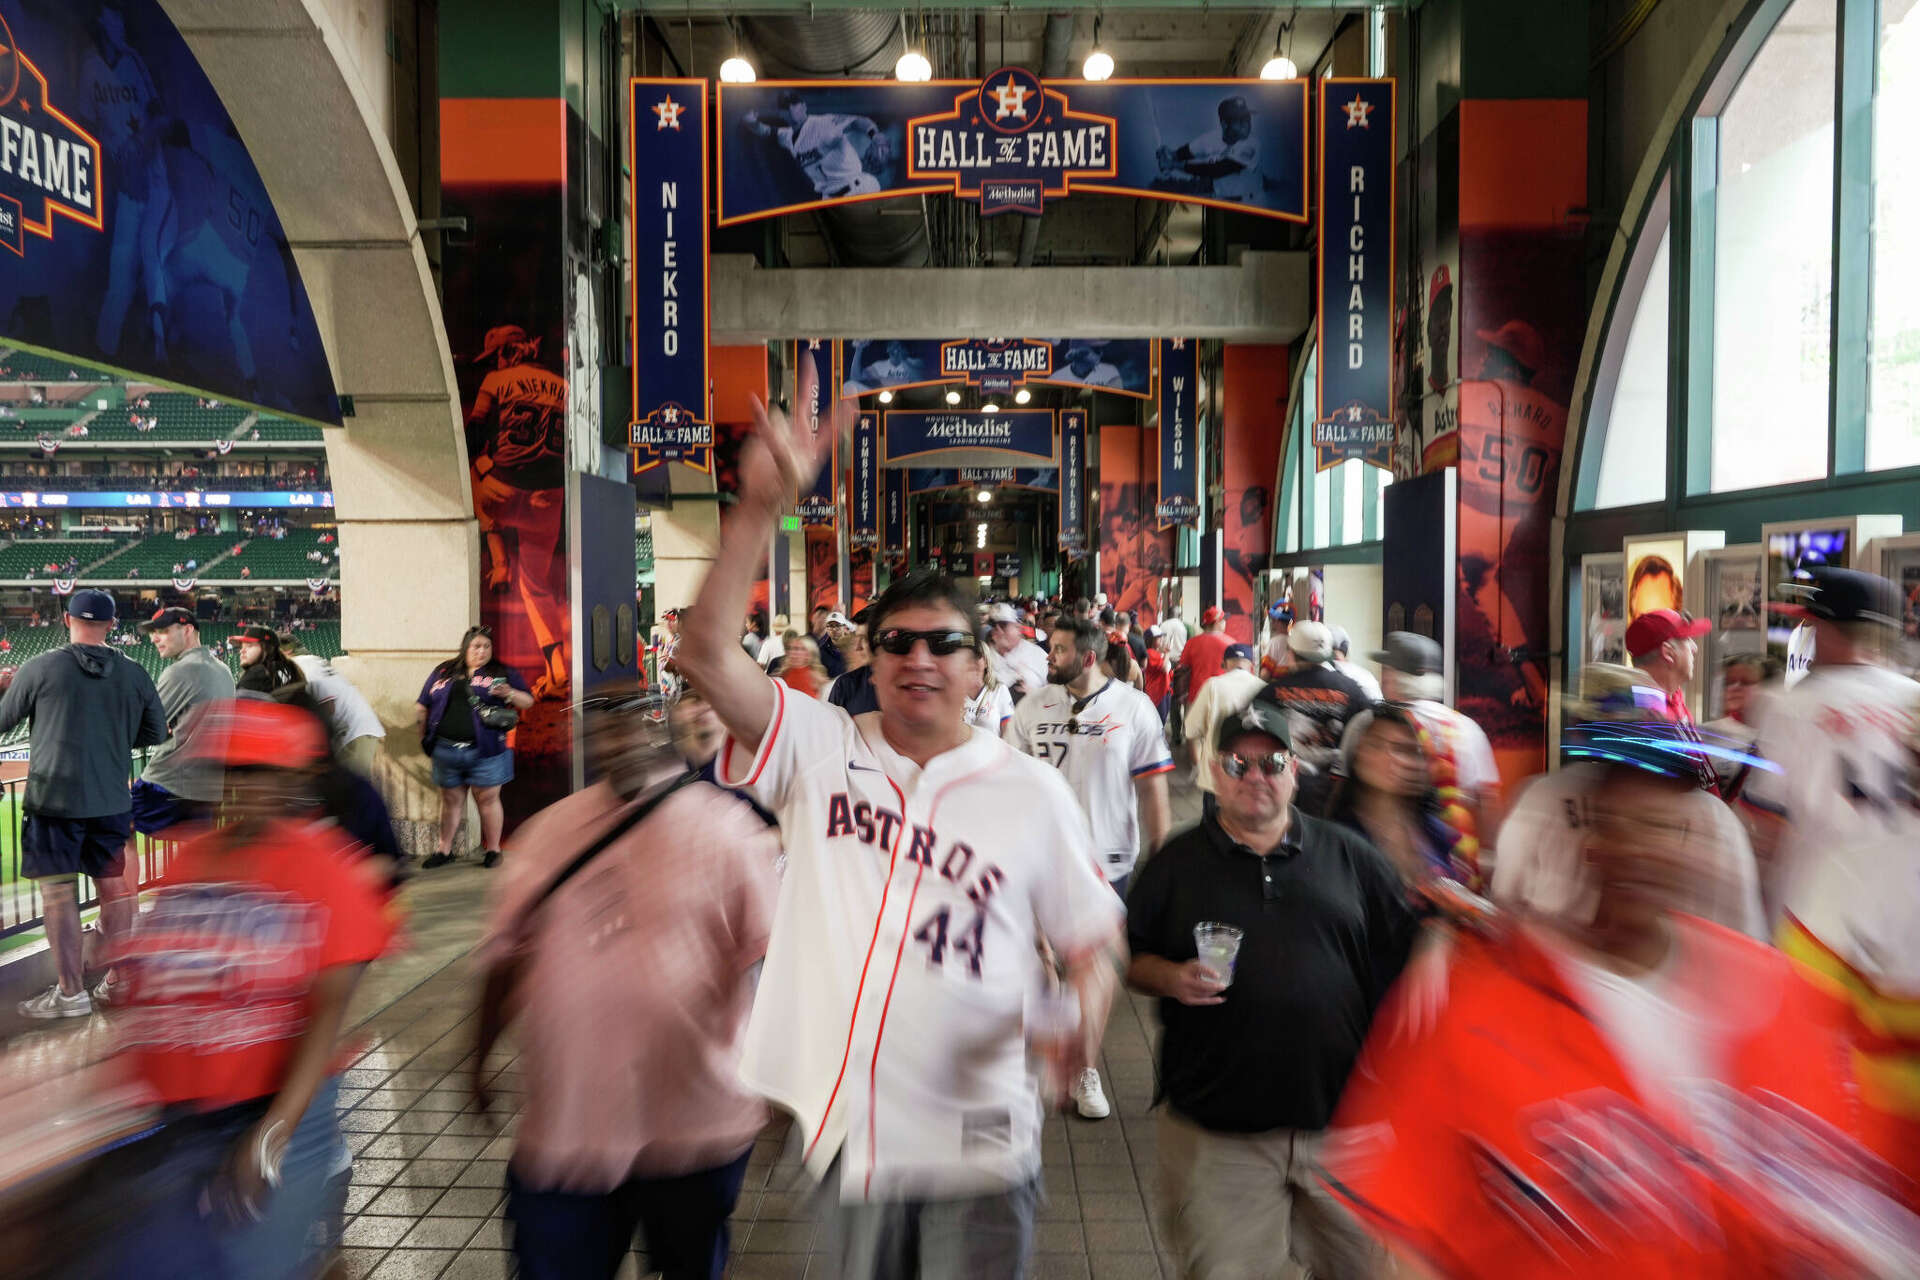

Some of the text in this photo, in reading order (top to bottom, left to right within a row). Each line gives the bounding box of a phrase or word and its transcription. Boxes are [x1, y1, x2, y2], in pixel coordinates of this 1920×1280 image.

[0, 113, 92, 209] FAME
[917, 126, 992, 169] HALL
[1026, 125, 1106, 168] FAME
[661, 181, 679, 357] NIEKRO
[1348, 165, 1365, 370] RICHARD
[945, 347, 986, 371] HALL
[1003, 346, 1047, 371] FAME
[632, 425, 664, 444] HALL
[677, 425, 711, 444] FAME
[925, 418, 1012, 438] Methodist
[1172, 376, 1185, 471] WILSON
[1316, 423, 1348, 442] HALL
[1361, 423, 1394, 442] FAME
[860, 436, 869, 522] UMBRICHT
[961, 467, 983, 481] HALL
[990, 466, 1014, 481] FAME
[1069, 435, 1077, 521] REYNOLDS
[1479, 434, 1549, 494] 50
[783, 517, 800, 530] EXIT
[826, 792, 1006, 904] ASTROS
[914, 902, 986, 984] 44
